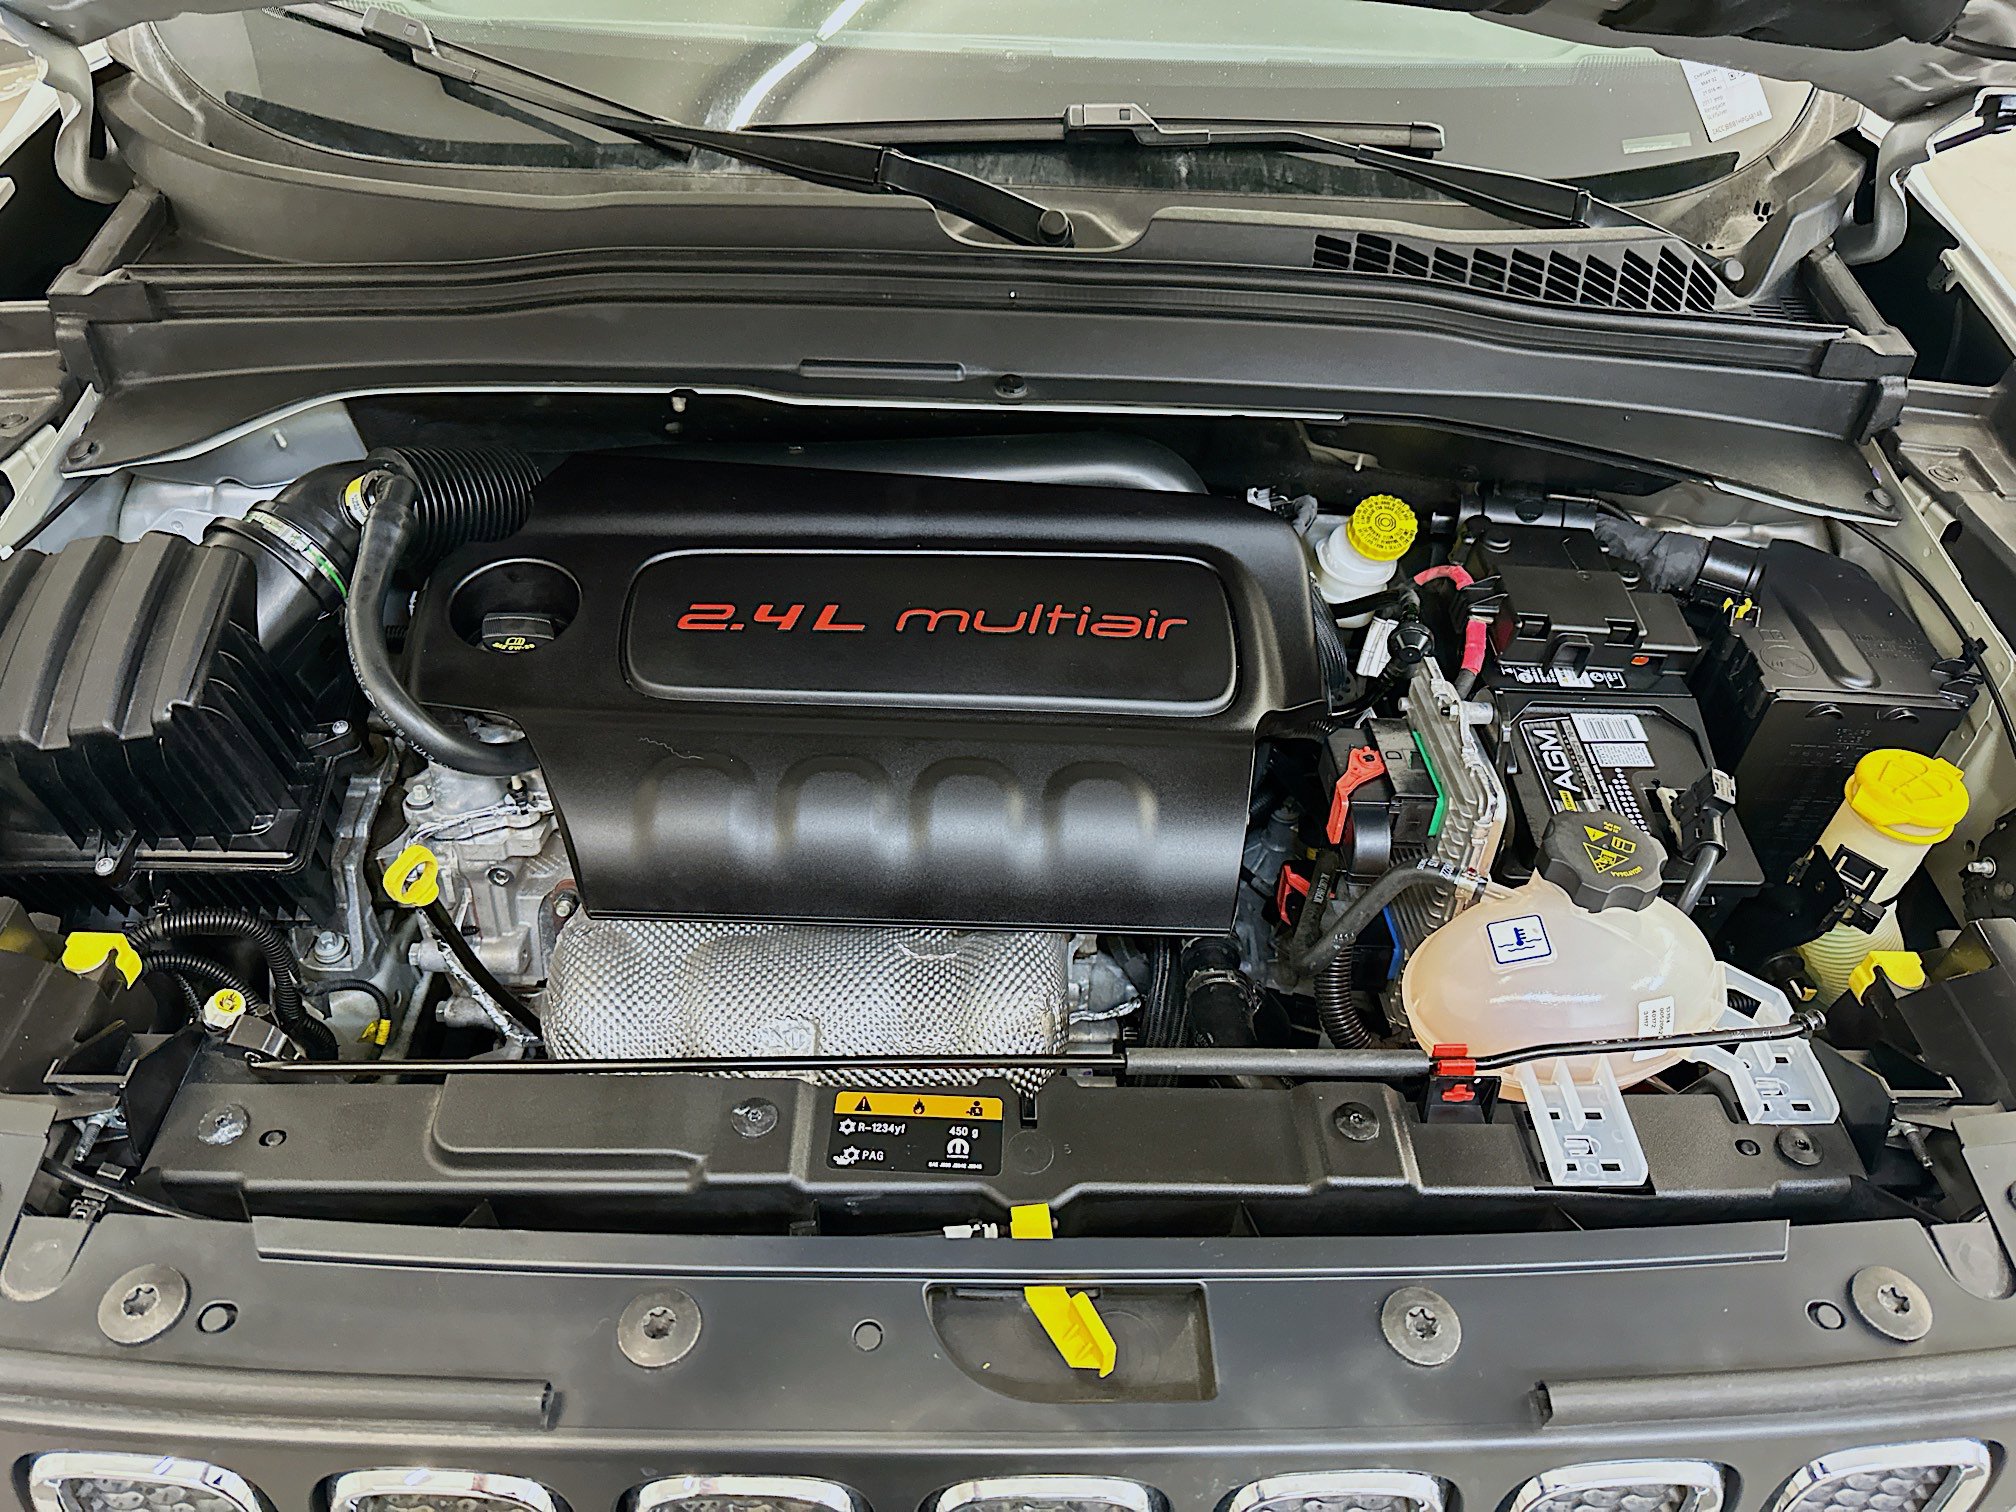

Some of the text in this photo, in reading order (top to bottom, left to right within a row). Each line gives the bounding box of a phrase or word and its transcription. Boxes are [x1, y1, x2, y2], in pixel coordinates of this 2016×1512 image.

[895, 603, 1189, 641] multiair
[1532, 729, 1582, 793] AGM
[858, 1122, 979, 1139] R-1234yf 450 g
[861, 1150, 885, 1161] PAG
